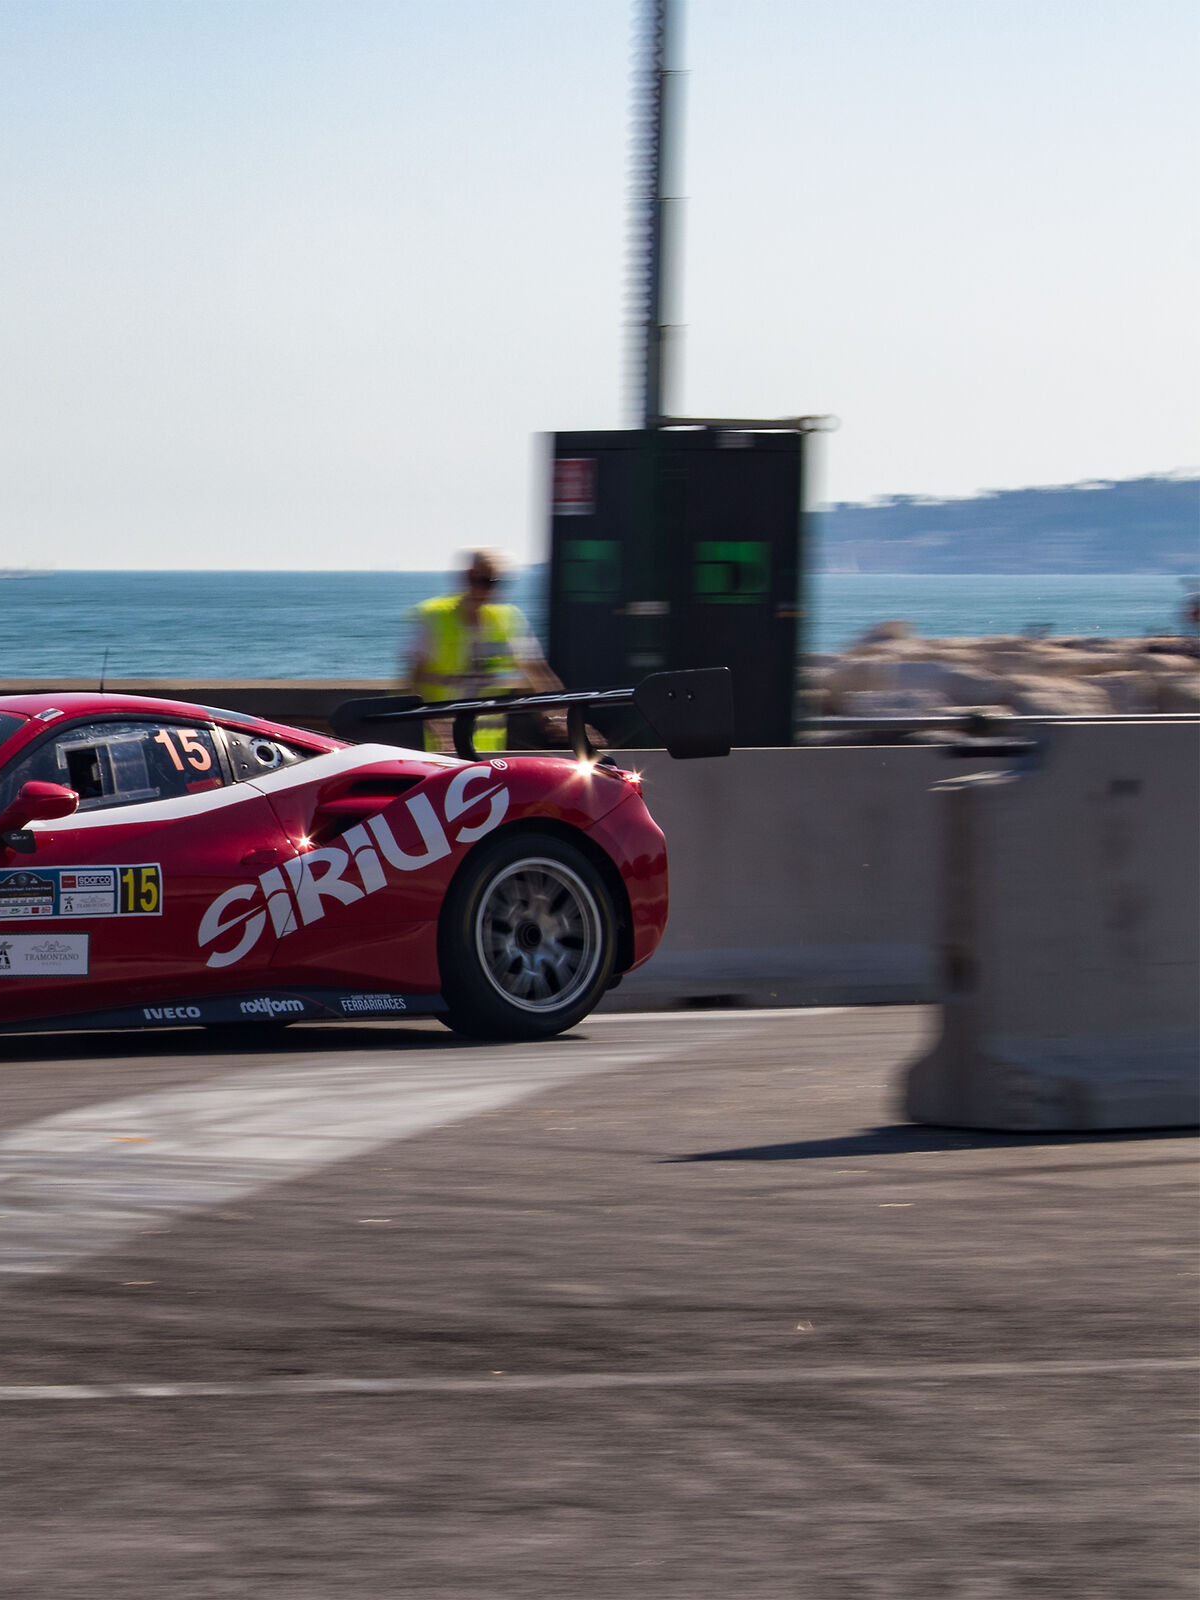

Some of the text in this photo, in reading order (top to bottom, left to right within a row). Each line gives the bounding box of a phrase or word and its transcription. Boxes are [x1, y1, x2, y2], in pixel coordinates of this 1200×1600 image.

[154, 729, 212, 771] 15
[122, 868, 158, 911] 15
[24, 953, 79, 961] TRAMONTANO
[143, 1006, 201, 1020] IVECO
[240, 997, 304, 1017] rotiform
[341, 999, 407, 1012] FERRARIRACES
